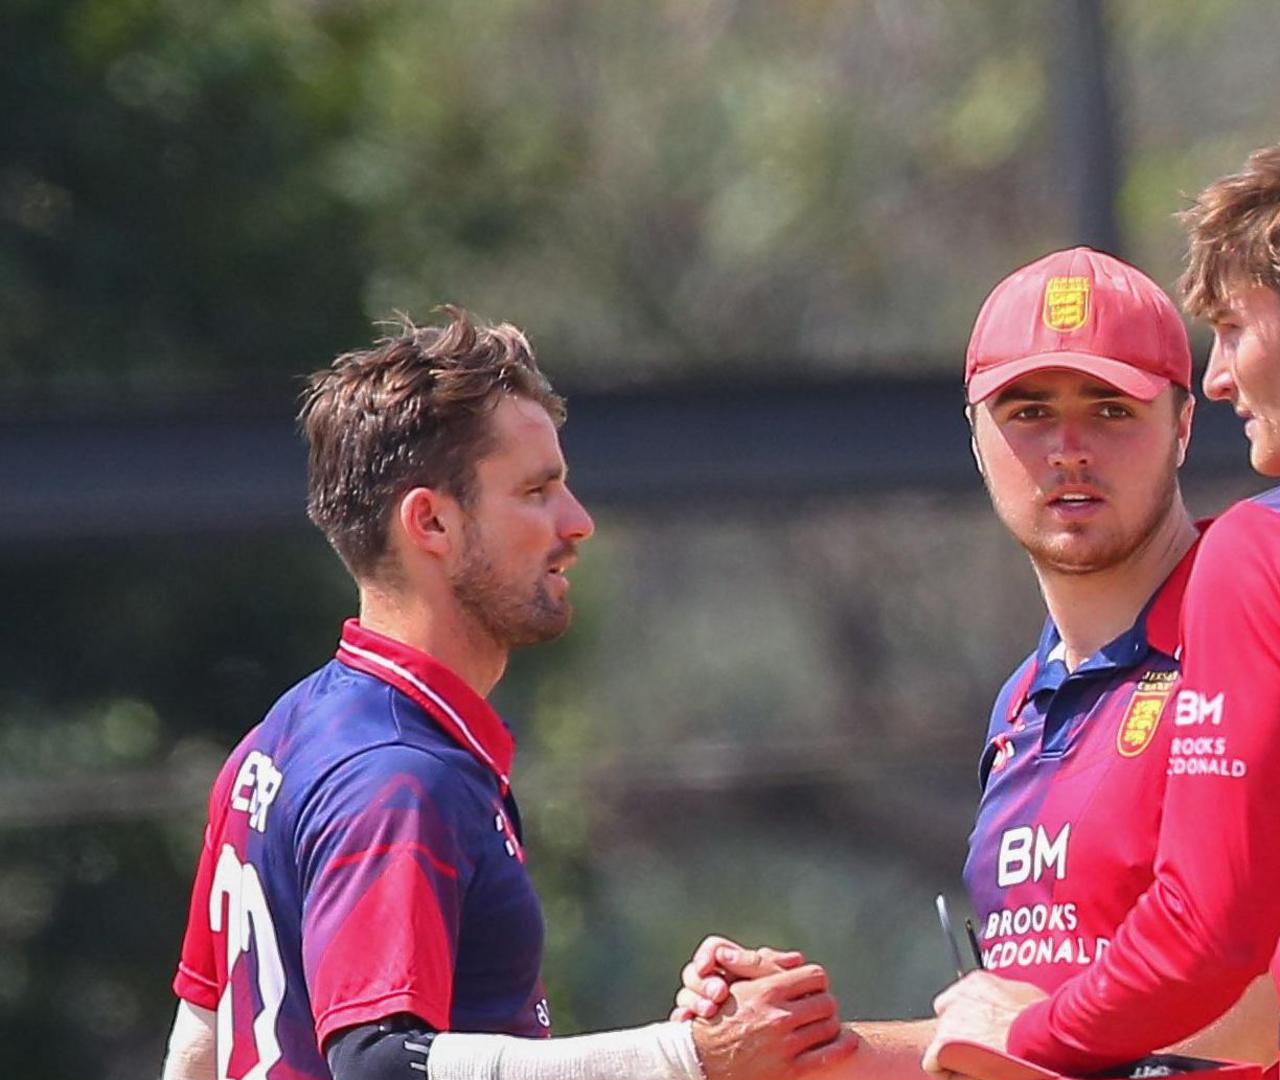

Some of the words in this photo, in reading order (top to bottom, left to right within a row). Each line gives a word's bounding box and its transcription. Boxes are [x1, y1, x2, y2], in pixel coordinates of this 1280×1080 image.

[1175, 689, 1225, 727] BM
[998, 822, 1071, 888] BM
[984, 903, 1078, 940] BROOKS
